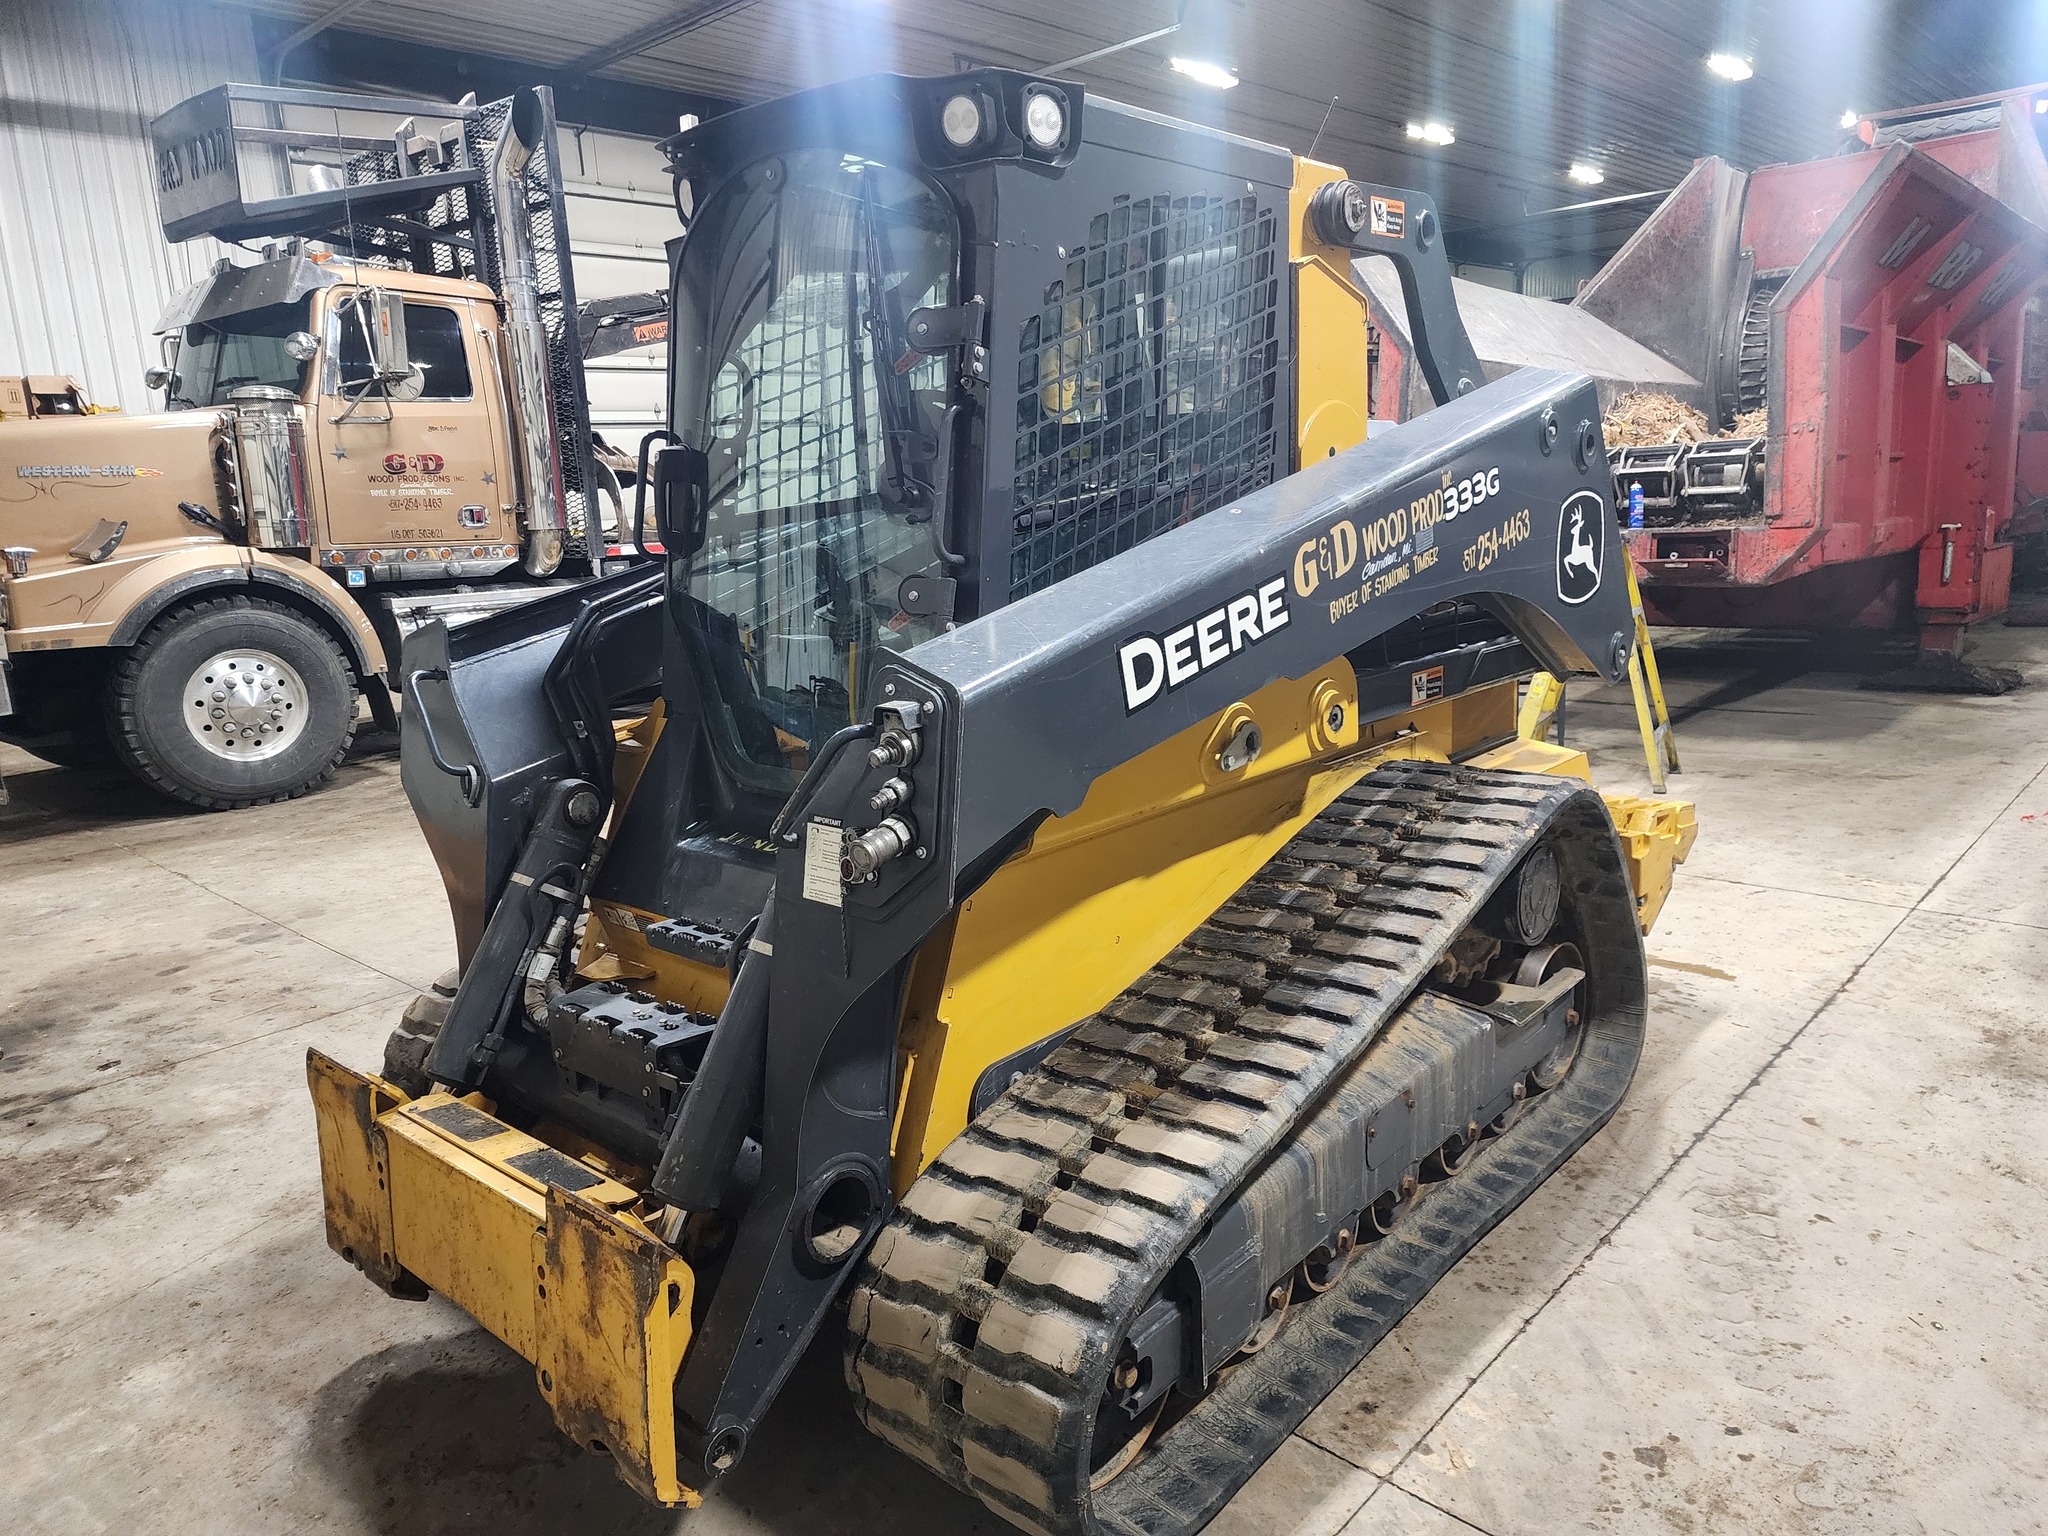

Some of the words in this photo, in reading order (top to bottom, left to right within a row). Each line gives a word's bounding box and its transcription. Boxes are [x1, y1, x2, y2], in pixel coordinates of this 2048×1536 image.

[17, 466, 90, 478] WESTERN
[382, 453, 445, 475] G&D
[367, 475, 394, 483] WOOD
[1444, 467, 1500, 522] 333G
[402, 530, 415, 539] DOT
[1293, 520, 1358, 598] G&D
[1362, 508, 1407, 561] WOOD
[1462, 544, 1477, 572] 517
[1329, 592, 1359, 625] BUYER
[1361, 581, 1373, 605] OF
[1374, 562, 1410, 597] STANDING
[1412, 546, 1439, 575] TIMBER
[1119, 576, 1290, 710] DEERE
[813, 815, 841, 826] IMPORTANT
